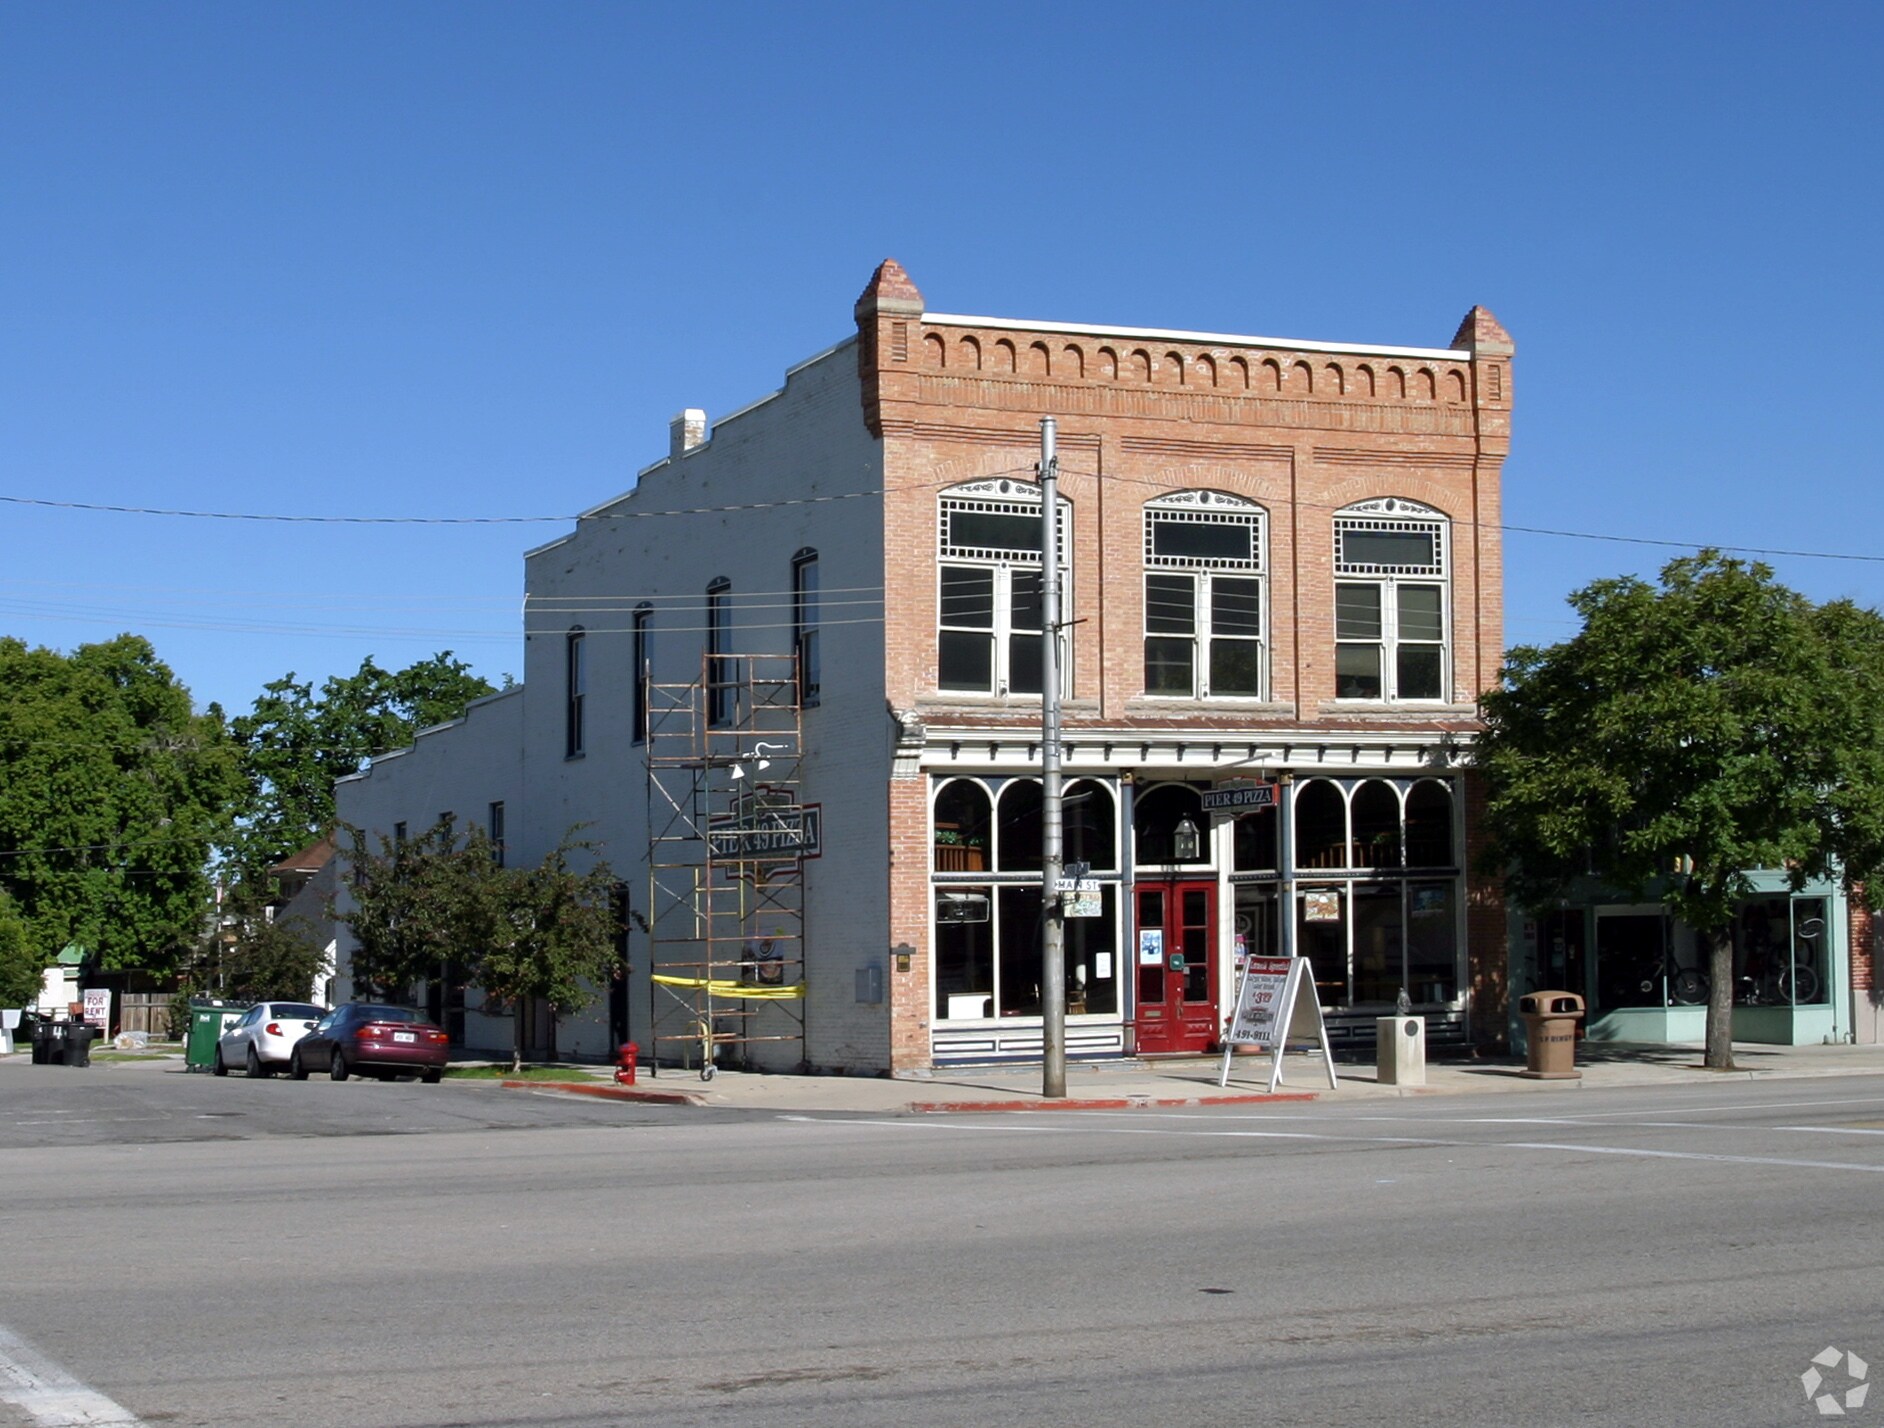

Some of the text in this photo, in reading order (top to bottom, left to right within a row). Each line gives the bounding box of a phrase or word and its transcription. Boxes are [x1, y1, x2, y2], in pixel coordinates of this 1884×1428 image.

[1205, 789, 1271, 807] PIER 49 PIZZA
[712, 825, 751, 854] PIER
[753, 822, 769, 850] 49
[1059, 880, 1097, 890] MAN ST
[87, 996, 104, 1006] FOR
[85, 1007, 106, 1016] RENT
